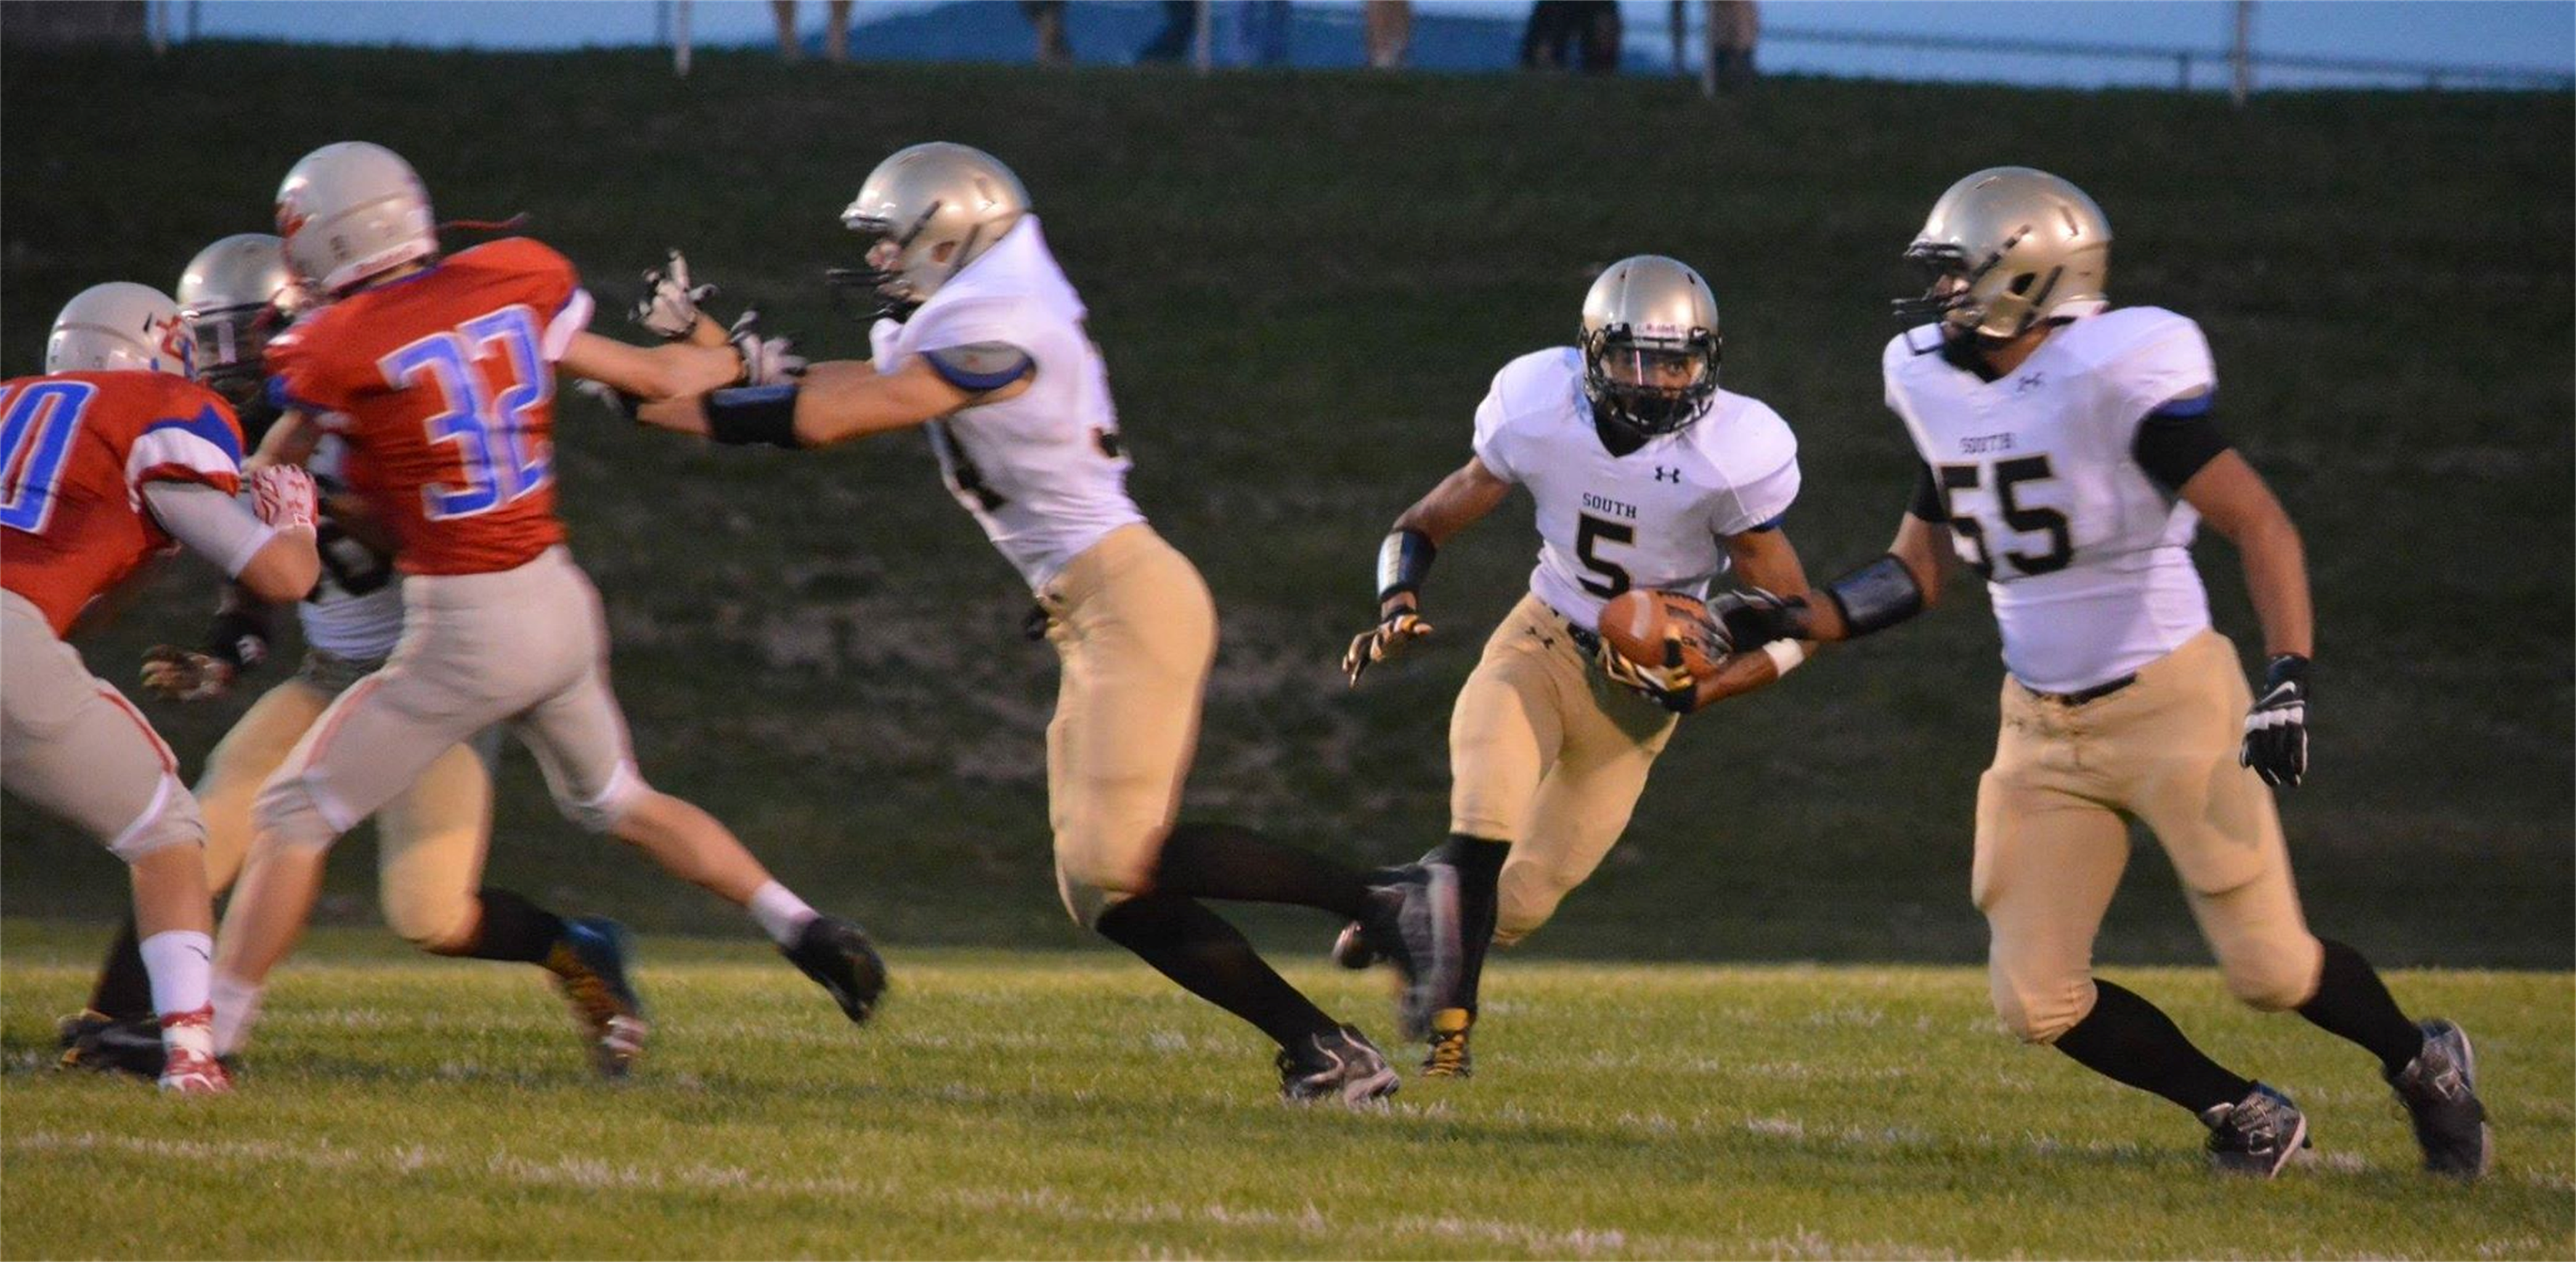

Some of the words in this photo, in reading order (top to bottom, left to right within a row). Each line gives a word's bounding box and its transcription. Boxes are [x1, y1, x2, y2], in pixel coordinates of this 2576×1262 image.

[0, 380, 99, 534] 0
[376, 303, 553, 521] 32
[1575, 510, 1637, 600] 5
[1582, 492, 1637, 519] SOUTH
[1940, 452, 2074, 580] 55
